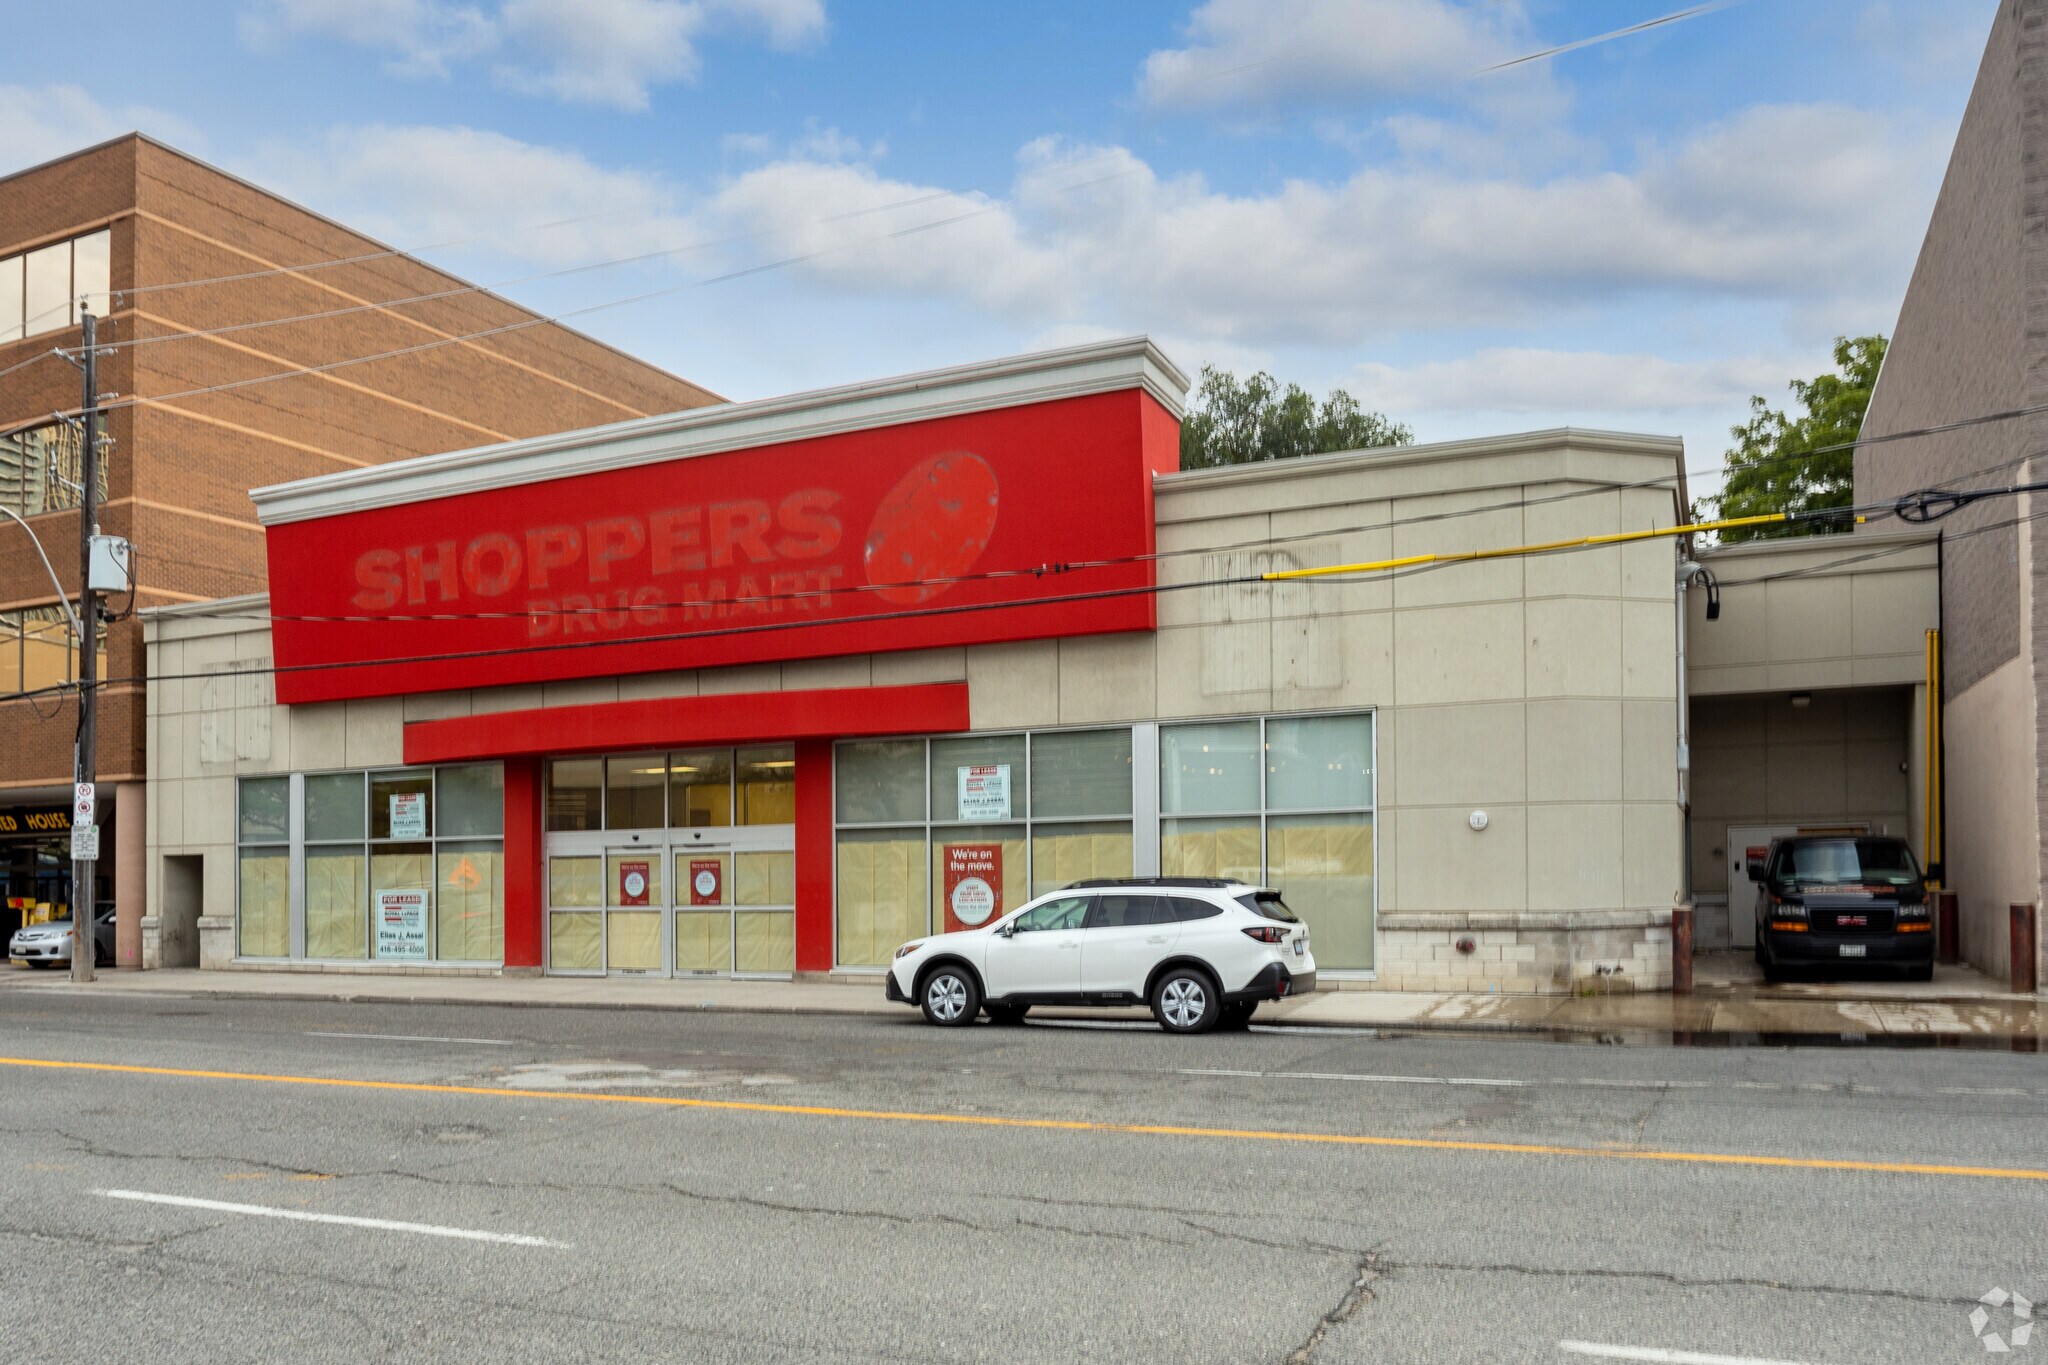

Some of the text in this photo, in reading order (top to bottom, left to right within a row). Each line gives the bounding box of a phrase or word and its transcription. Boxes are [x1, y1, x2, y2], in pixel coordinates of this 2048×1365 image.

[352, 487, 843, 610] SHOPPERS
[527, 565, 843, 638] DRUG MART
[25, 812, 70, 830] HOUSE
[952, 848, 992, 860] We're on
[950, 861, 965, 871] the
[383, 895, 421, 904] FOR LEASE
[380, 931, 396, 939] Elias
[406, 931, 424, 939] Assal
